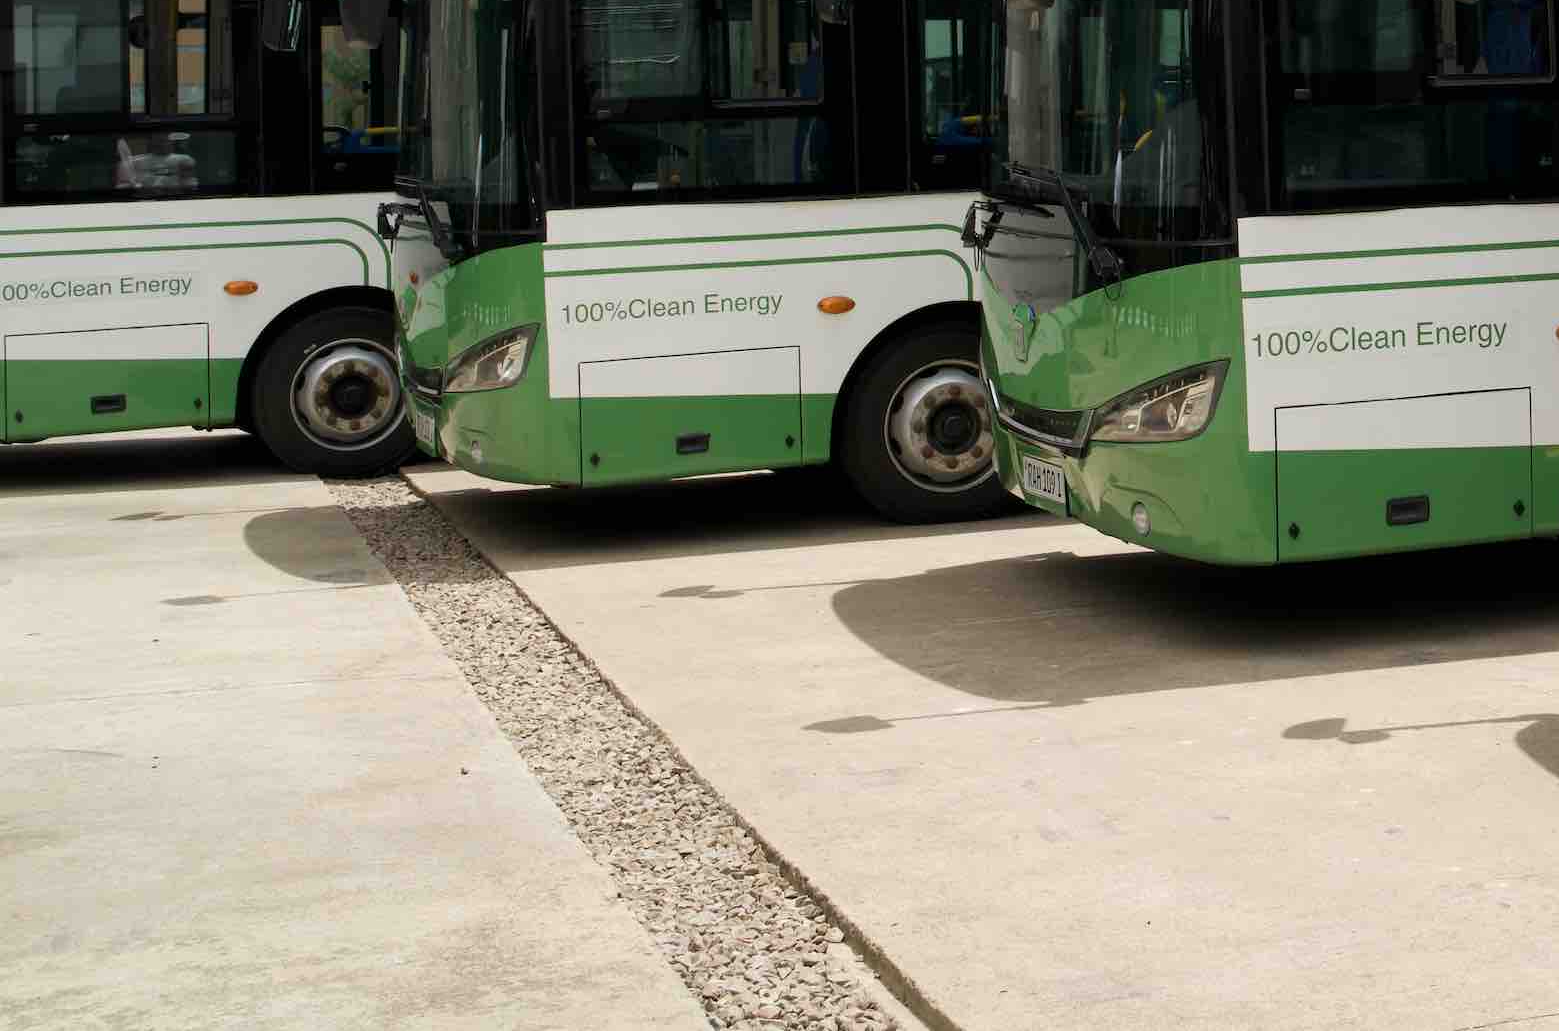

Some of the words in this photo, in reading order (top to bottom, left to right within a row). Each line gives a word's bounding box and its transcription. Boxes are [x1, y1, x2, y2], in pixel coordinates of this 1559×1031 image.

[1, 280, 113, 302] 00%Clean
[120, 275, 193, 296] Energy
[562, 298, 696, 325] 100%Clean
[704, 292, 784, 316] Energy
[1252, 326, 1407, 358] 100%Clean
[1417, 321, 1508, 348] Energy
